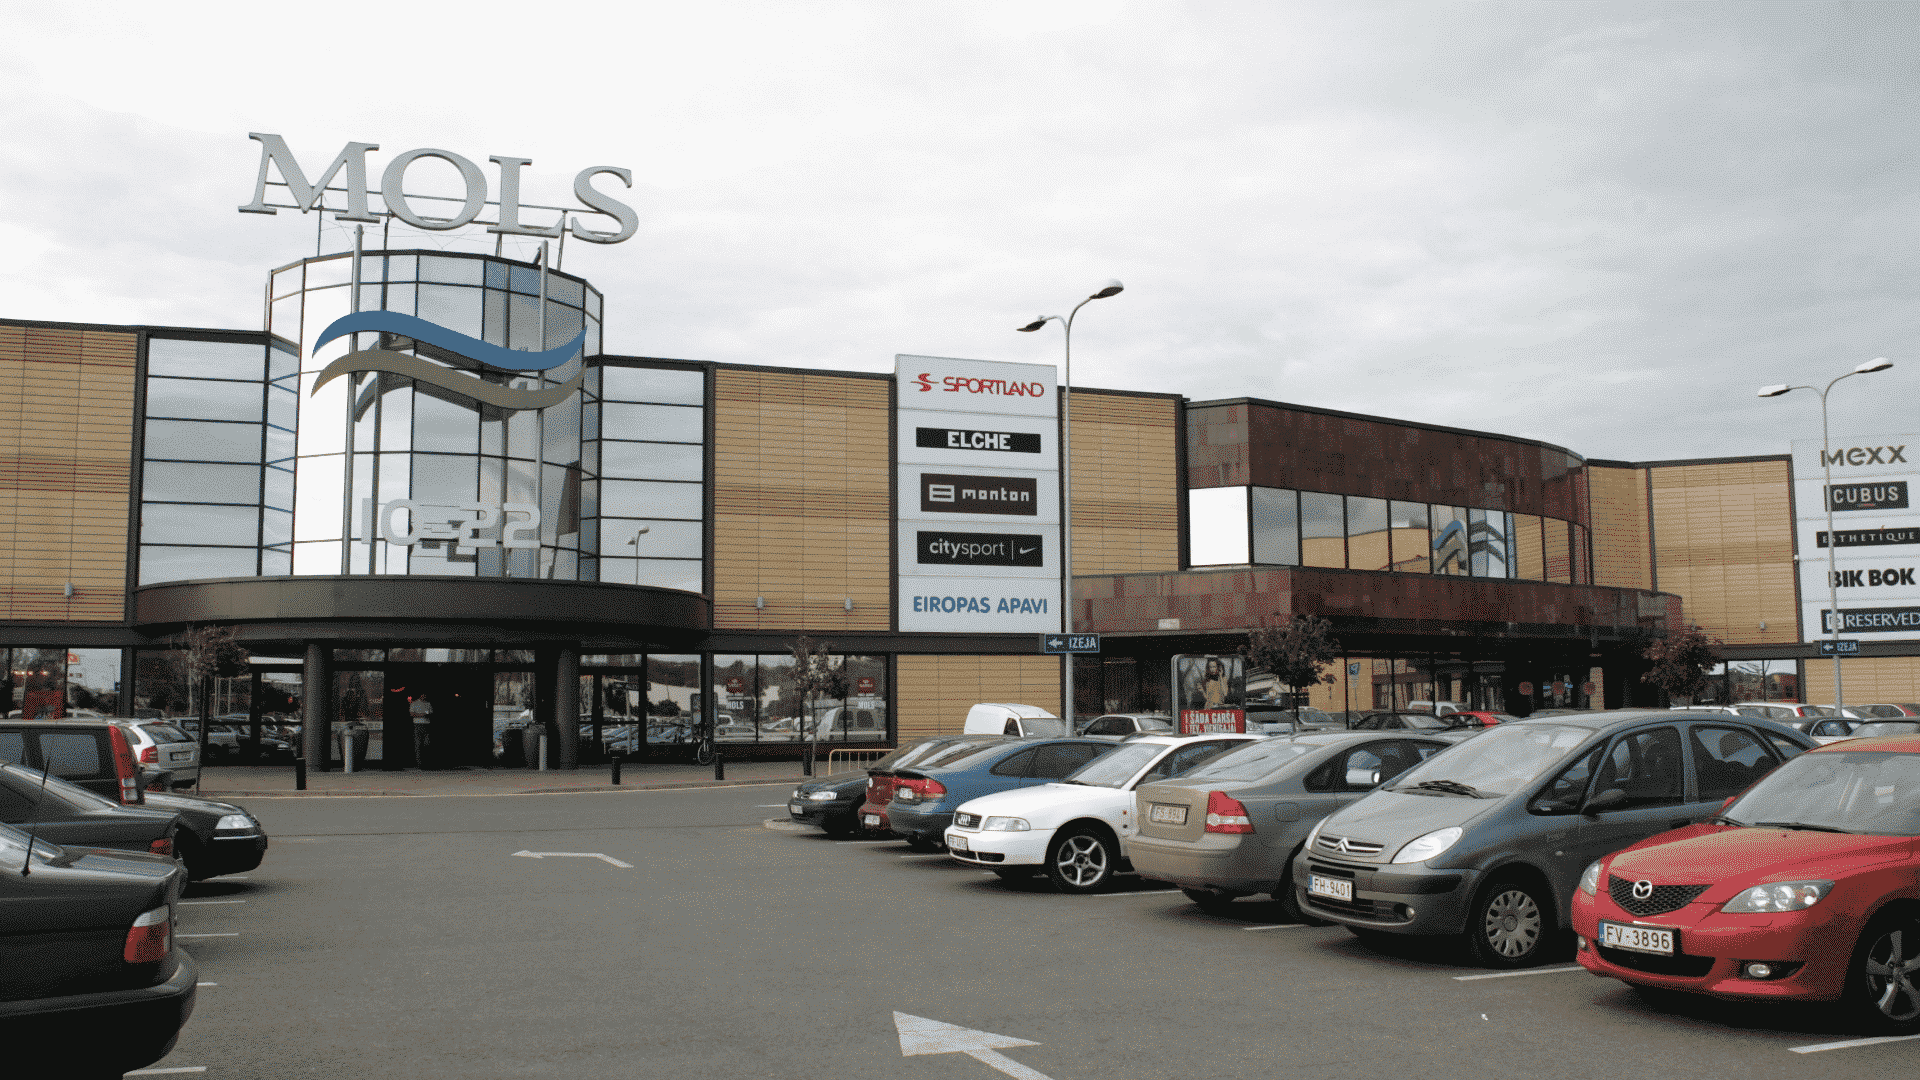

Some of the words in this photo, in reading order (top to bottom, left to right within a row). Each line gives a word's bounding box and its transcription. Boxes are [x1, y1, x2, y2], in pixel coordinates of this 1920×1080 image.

[238, 132, 640, 245] MOLS
[943, 376, 1044, 398] SPORTLAND
[947, 431, 1011, 450] ELCHE
[962, 487, 1029, 501] monton
[1833, 486, 1899, 504] CUBUS
[929, 538, 1005, 559] citysport
[1828, 570, 1864, 588] BIK
[1868, 567, 1916, 587] BOK
[913, 596, 991, 614] EIROPAS
[997, 597, 1048, 614] APAVI
[1845, 612, 1920, 628] RESERVED
[1069, 637, 1096, 649] IZEJA
[1314, 877, 1351, 898] FH-9401
[1606, 925, 1670, 950] FV-3896
